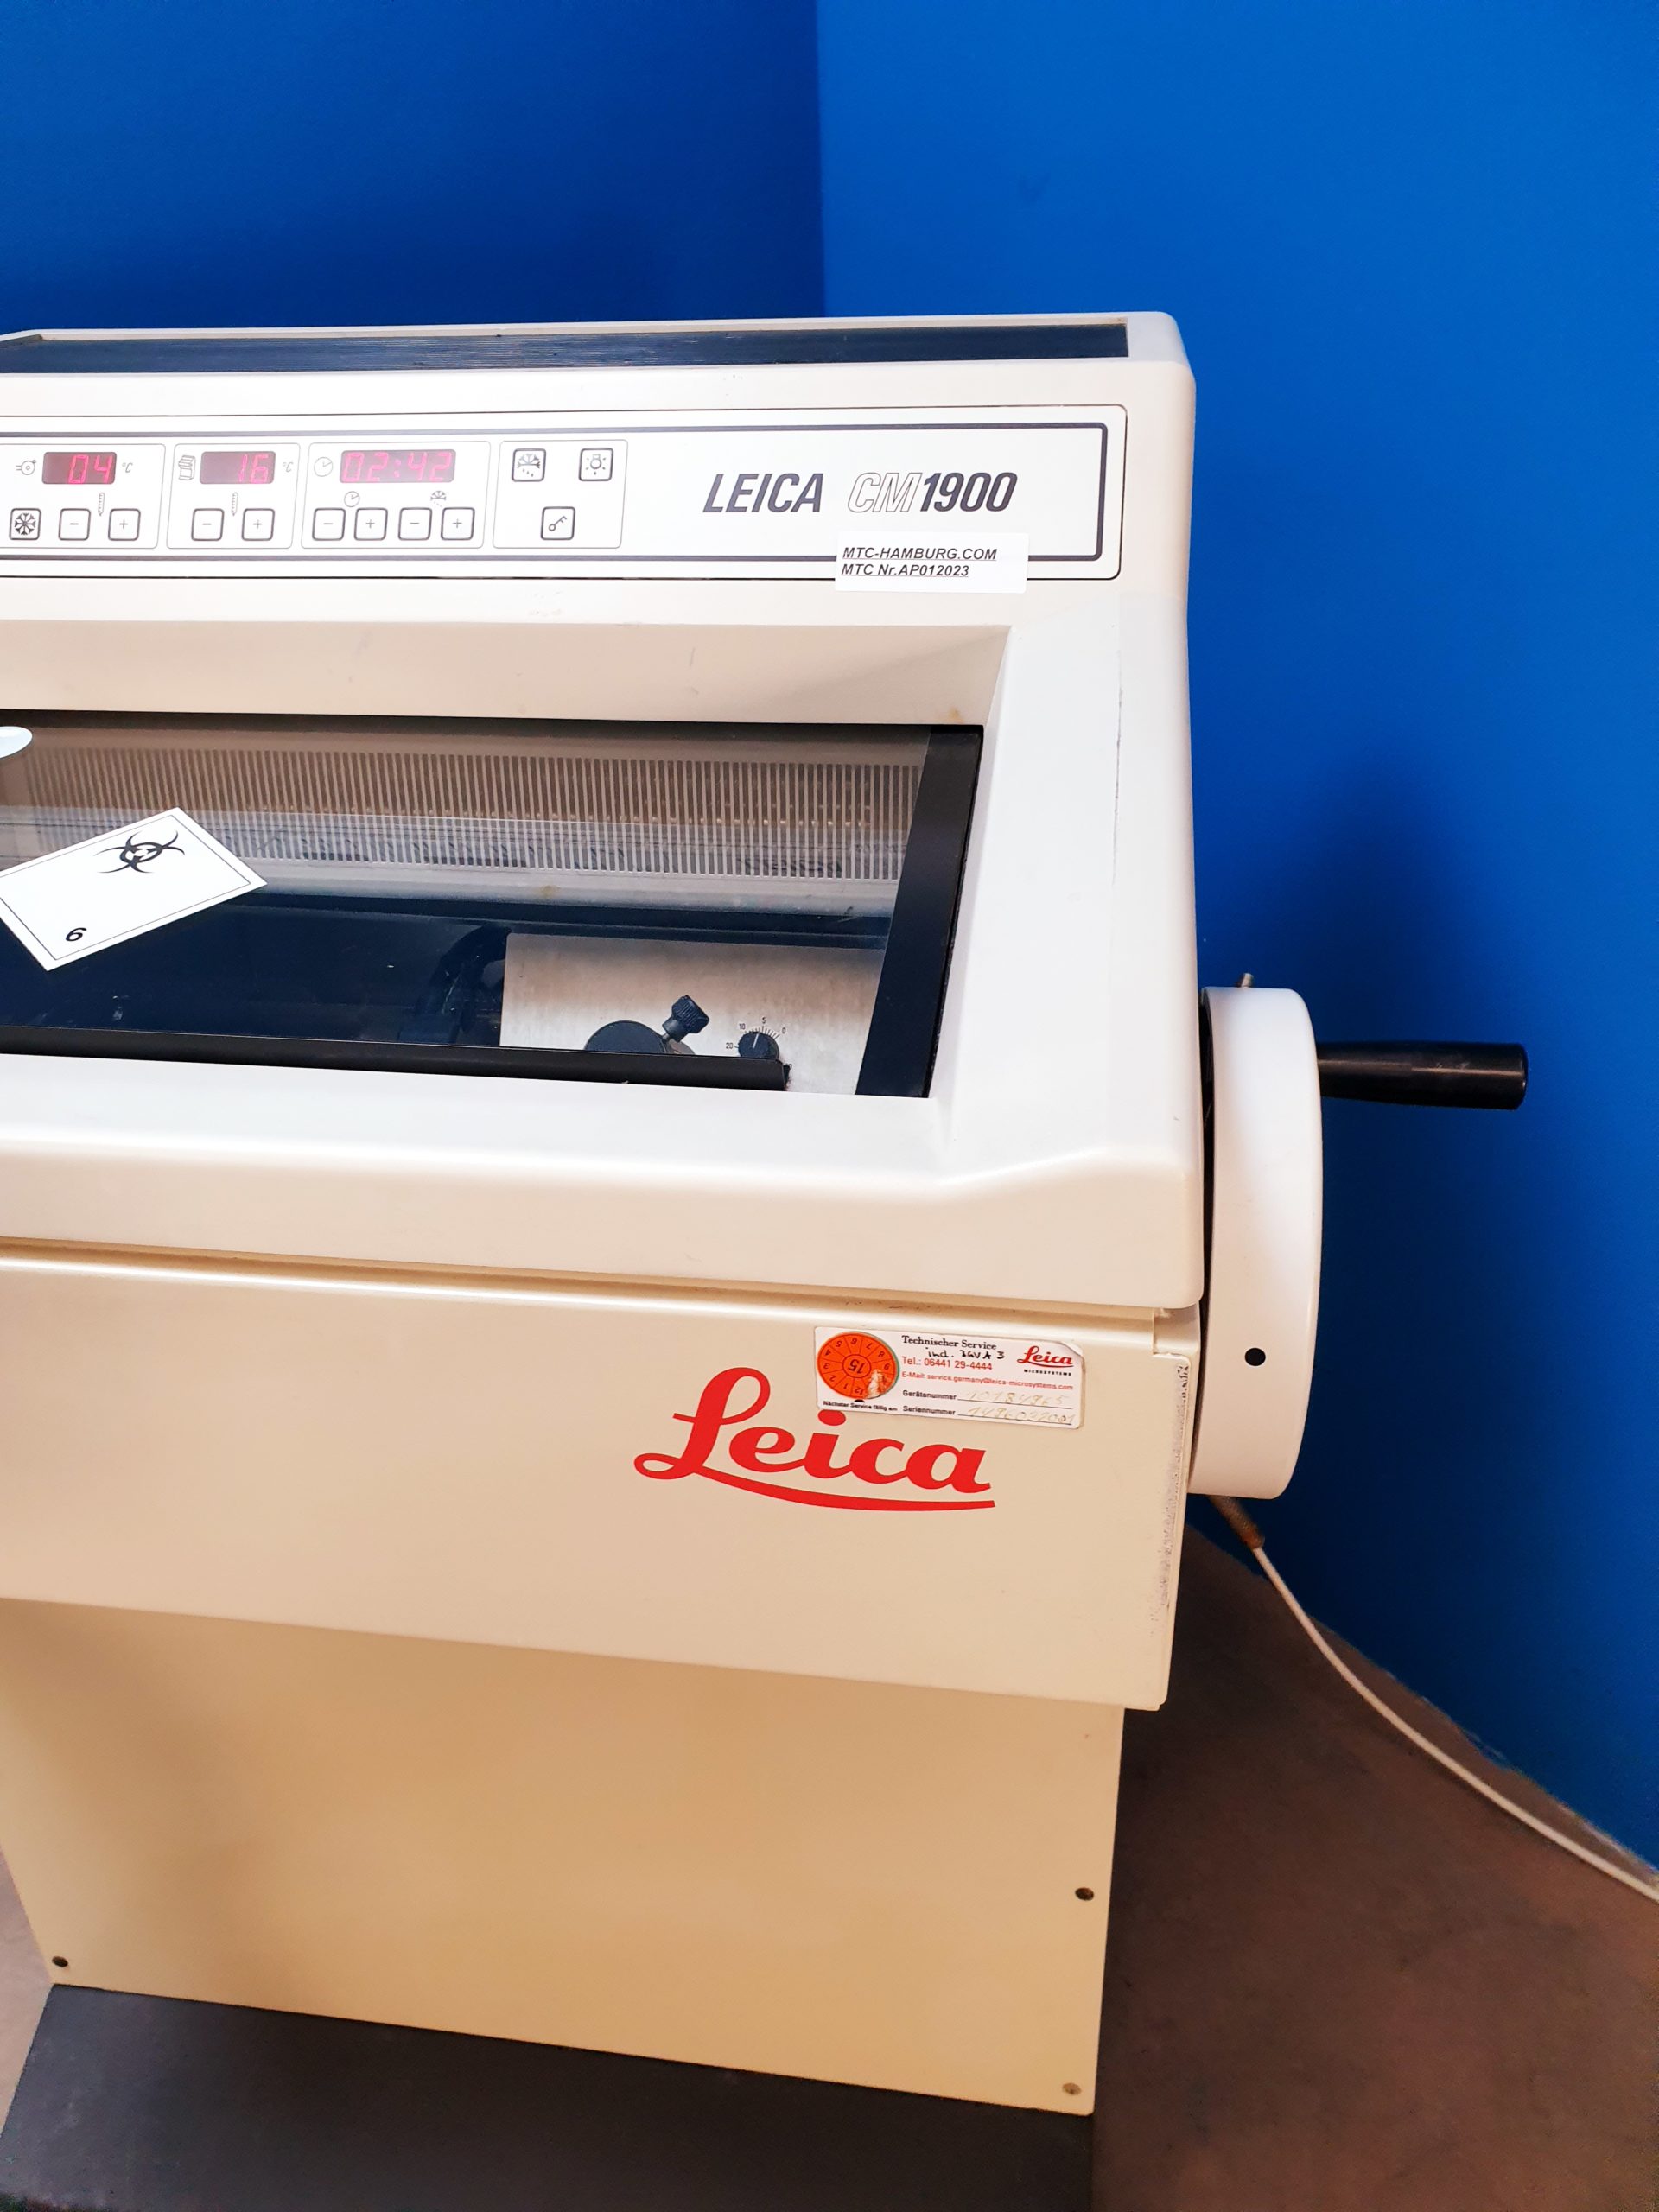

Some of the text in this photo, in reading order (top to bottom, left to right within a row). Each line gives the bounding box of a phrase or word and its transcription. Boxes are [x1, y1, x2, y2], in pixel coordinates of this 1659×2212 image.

[68, 454, 113, 484] 04
[122, 461, 133, 473] °C
[238, 454, 270, 484] 16
[341, 452, 453, 482] 02:42
[702, 472, 1019, 513] LEICA CM1900
[842, 547, 998, 560] MTC-HAMBURG.COM
[842, 563, 969, 577] MTC Nr.AP012023
[65, 927, 87, 942] 6
[902, 1335, 996, 1350] Technischer Service
[901, 1356, 993, 1370] Tel.: 06441 29-4444
[1016, 1345, 1074, 1368] Leica
[848, 1358, 866, 1374] 15
[850, 1402, 873, 1410] Service
[902, 1405, 956, 1415] Seriennummer
[633, 1367, 996, 1512] Leica
